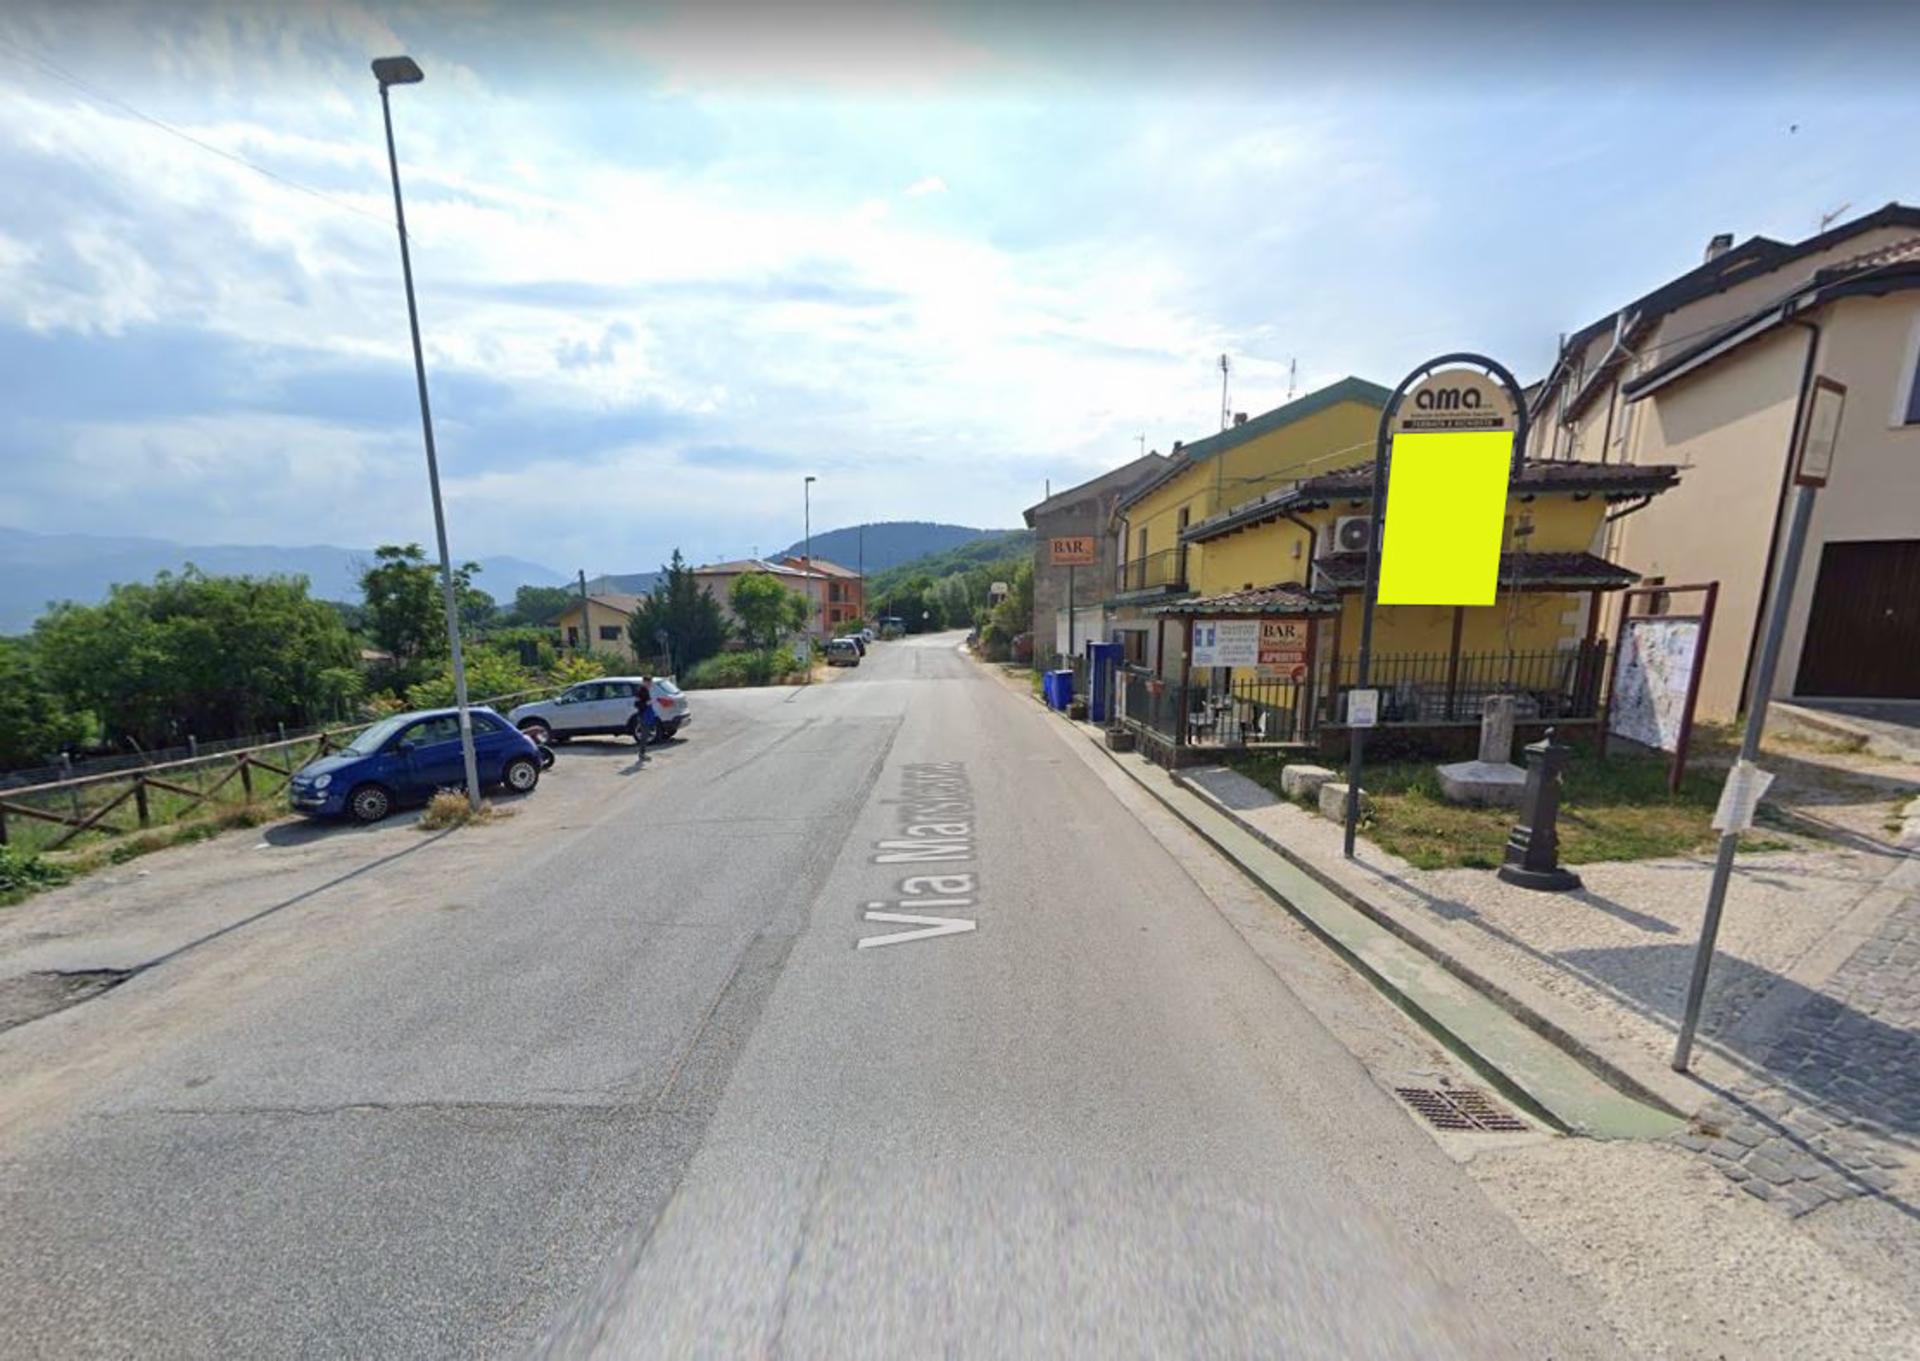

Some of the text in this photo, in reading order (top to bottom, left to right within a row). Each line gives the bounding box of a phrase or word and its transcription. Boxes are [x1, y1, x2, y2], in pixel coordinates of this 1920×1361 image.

[1415, 387, 1481, 410] ama
[1054, 540, 1083, 553] BAR
[1264, 625, 1295, 637] BAR
